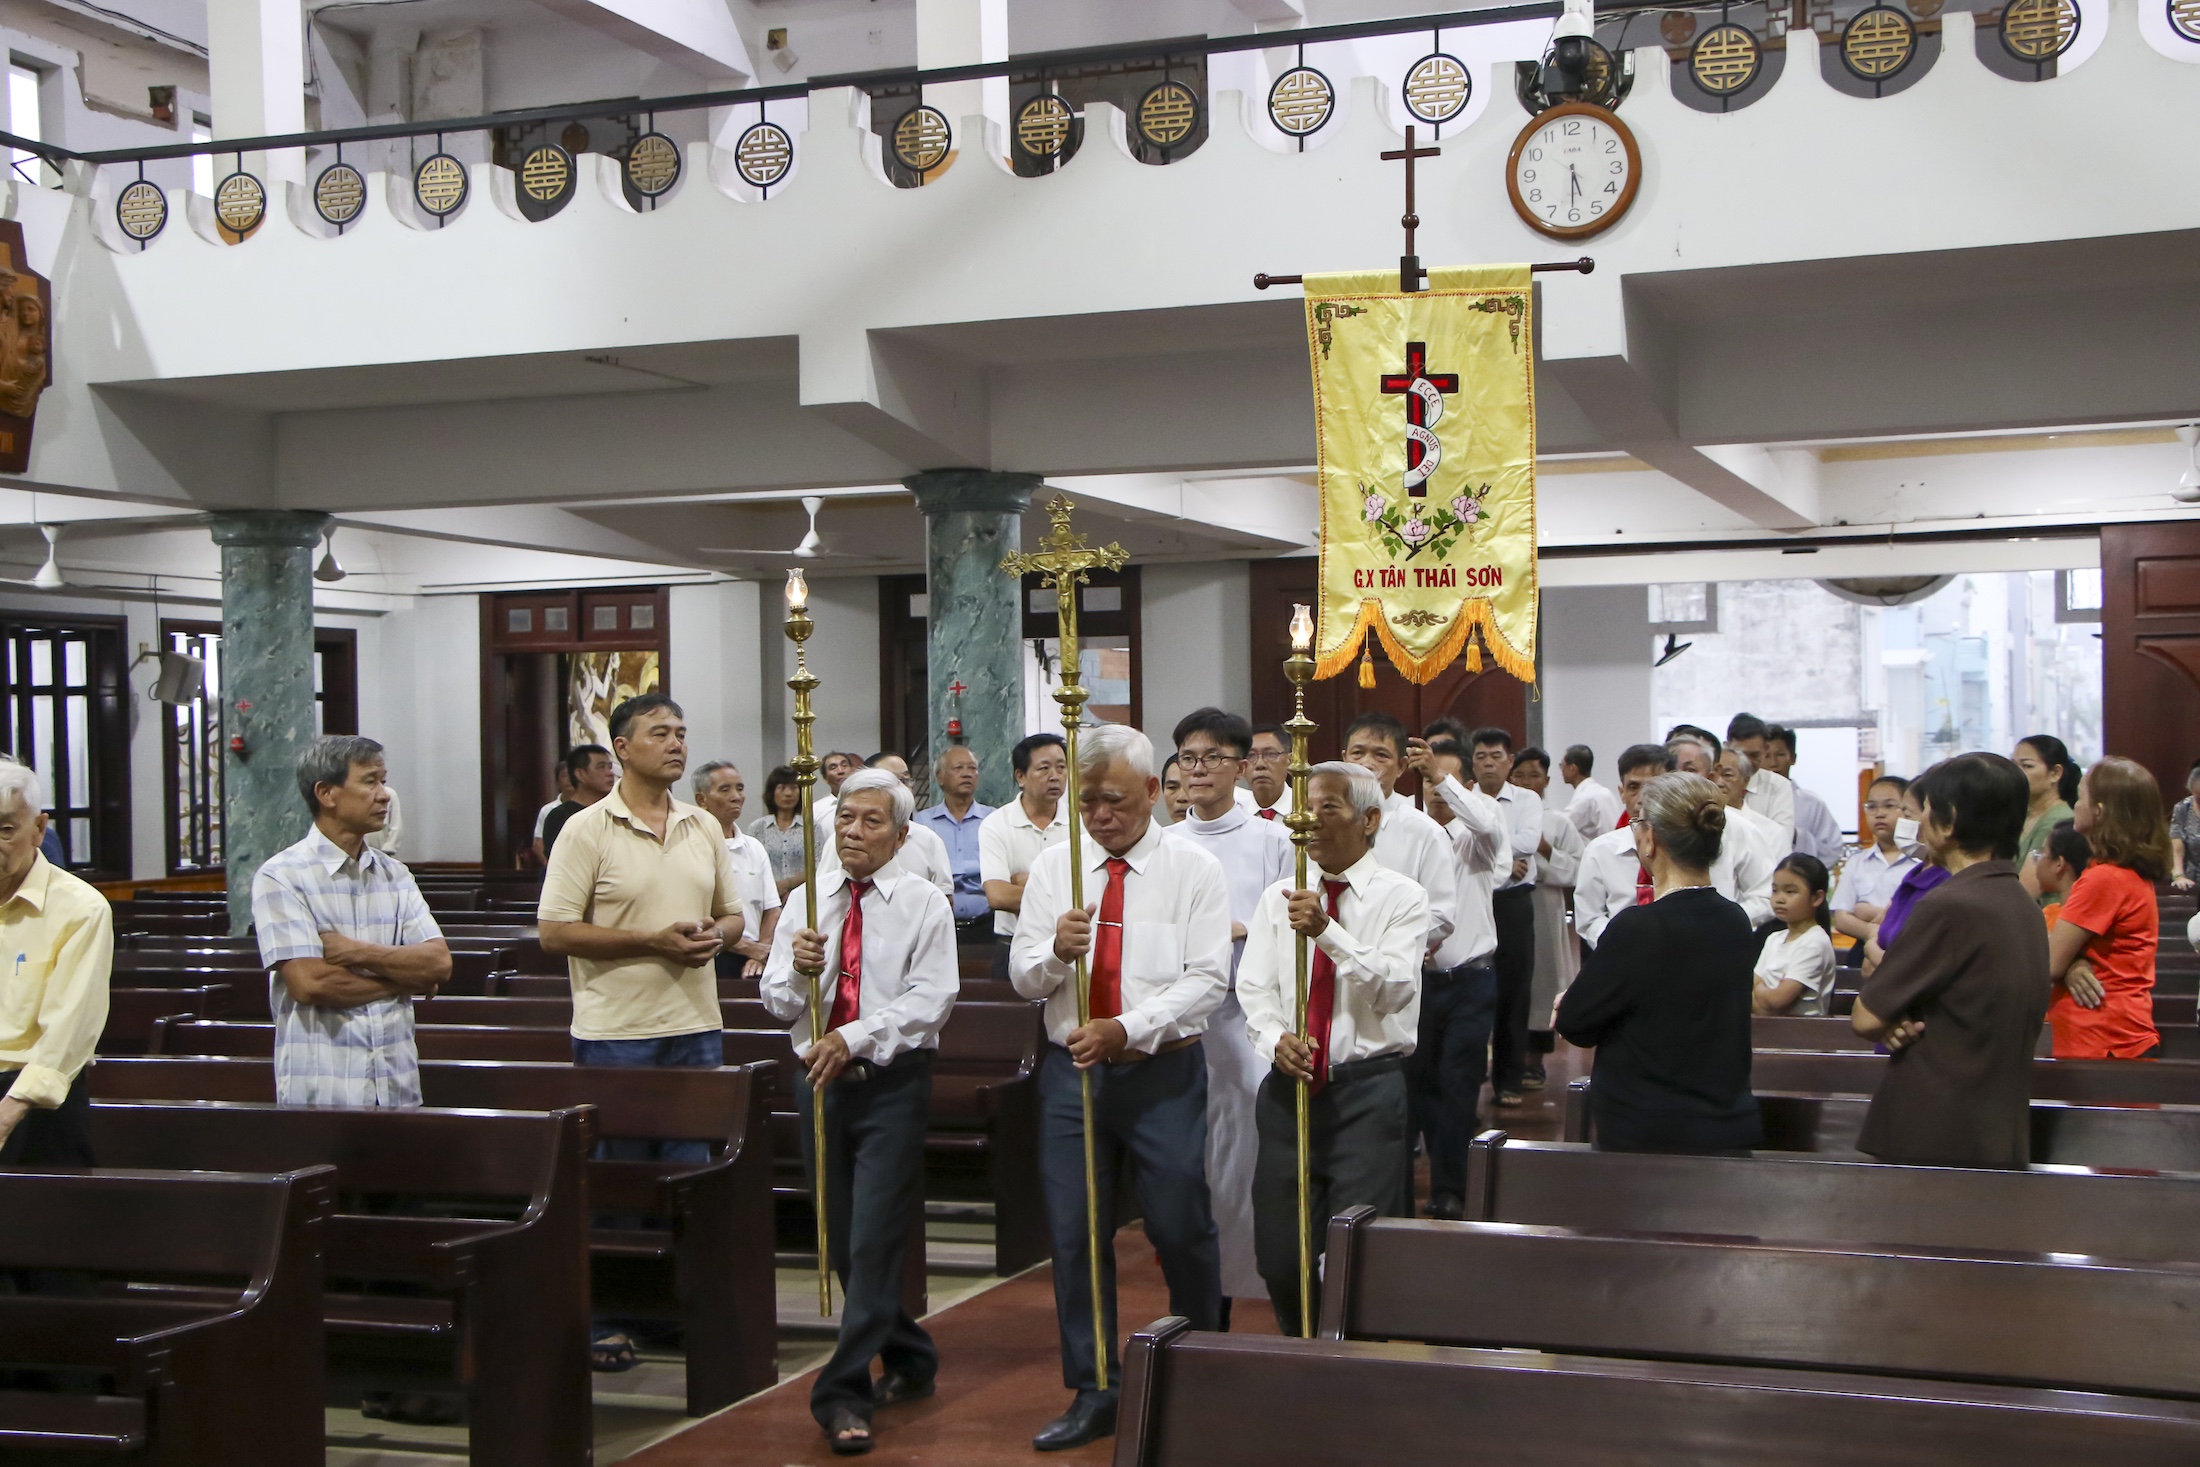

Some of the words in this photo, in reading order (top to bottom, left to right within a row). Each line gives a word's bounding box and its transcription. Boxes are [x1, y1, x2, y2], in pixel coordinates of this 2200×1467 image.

[1563, 121, 1581, 136] 12
[1592, 126, 1597, 141] 1
[1544, 130, 1554, 143] 11
[1605, 139, 1617, 154] 2
[1528, 147, 1543, 162] 10
[1610, 160, 1623, 175] 3
[1523, 169, 1536, 183] 9
[1529, 188, 1542, 202] 8
[1603, 181, 1618, 195] 4
[1546, 205, 1557, 219] 7
[1567, 208, 1581, 222] 6
[1590, 200, 1603, 215] 5
[1417, 382, 1440, 407] ECCE
[1411, 428, 1438, 451] AGNUS
[1418, 459, 1434, 477] DEI
[1354, 569, 1374, 588] G.X
[1379, 564, 1406, 588] TÂN
[1413, 563, 1456, 588] THÁI
[1466, 564, 1502, 587] SƠN
